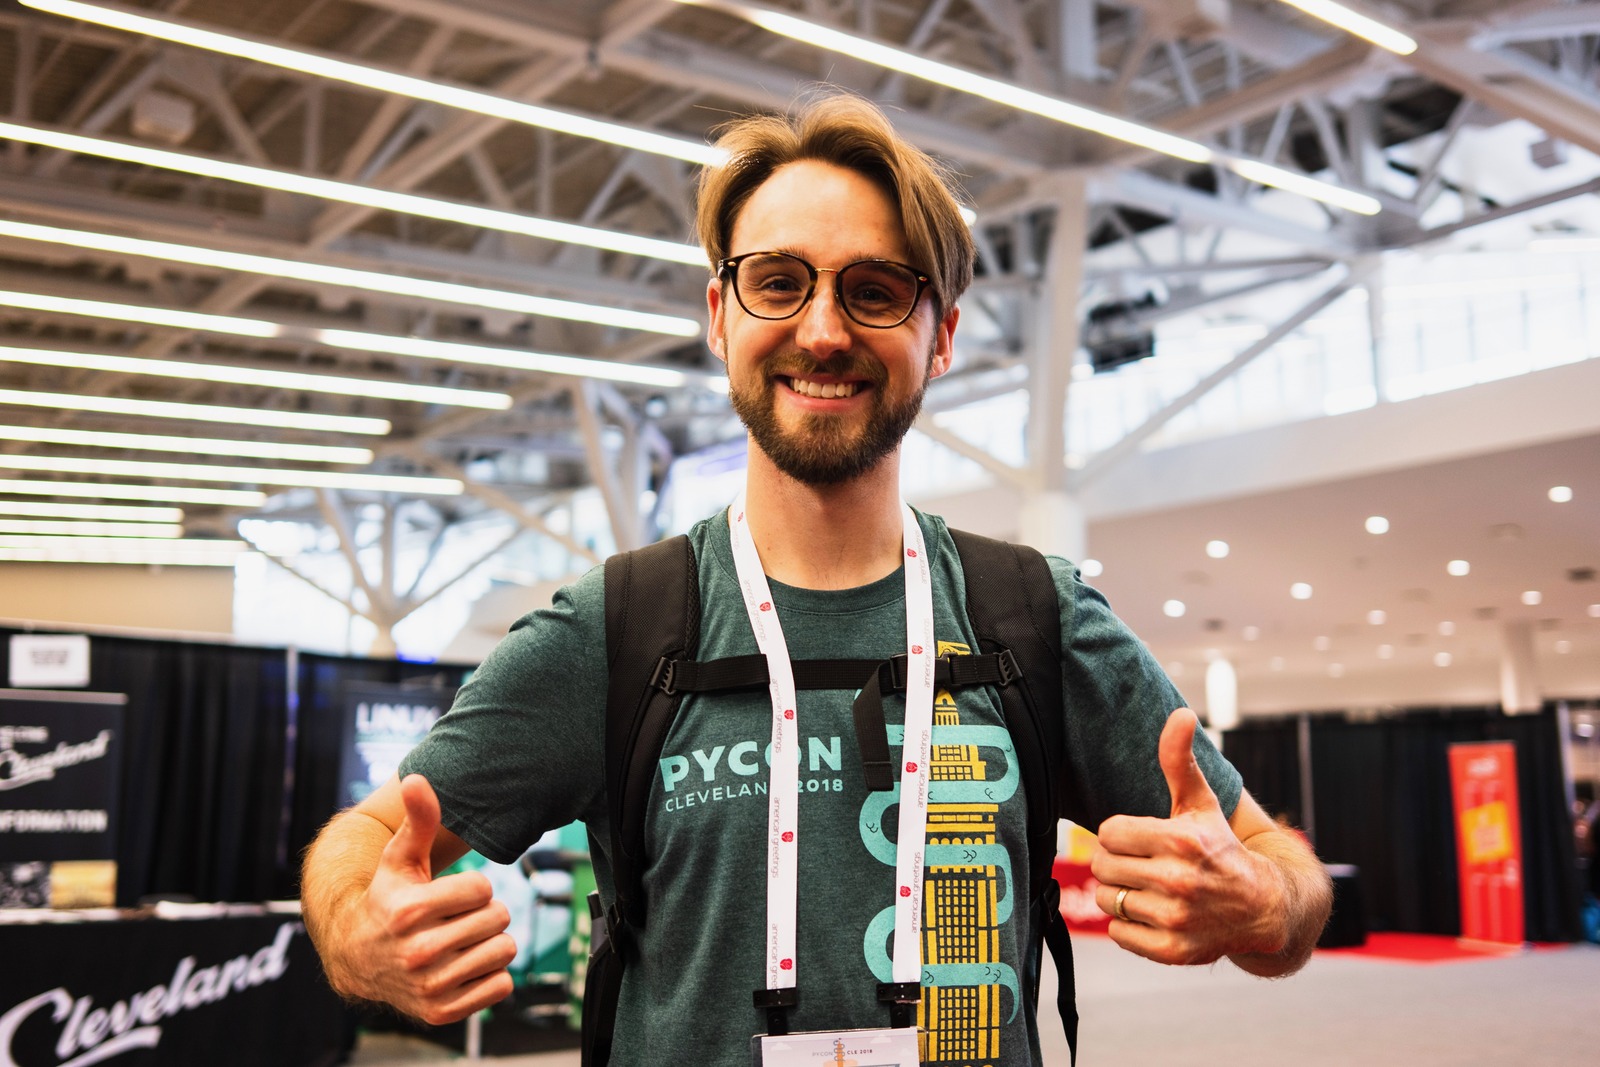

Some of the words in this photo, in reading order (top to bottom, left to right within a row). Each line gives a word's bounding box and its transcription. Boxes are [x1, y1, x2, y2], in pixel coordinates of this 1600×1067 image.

[775, 714, 783, 753] greetings
[920, 729, 929, 768] greetings
[659, 736, 842, 792] PYCN
[771, 837, 780, 878] greetings
[913, 851, 921, 893] greetings
